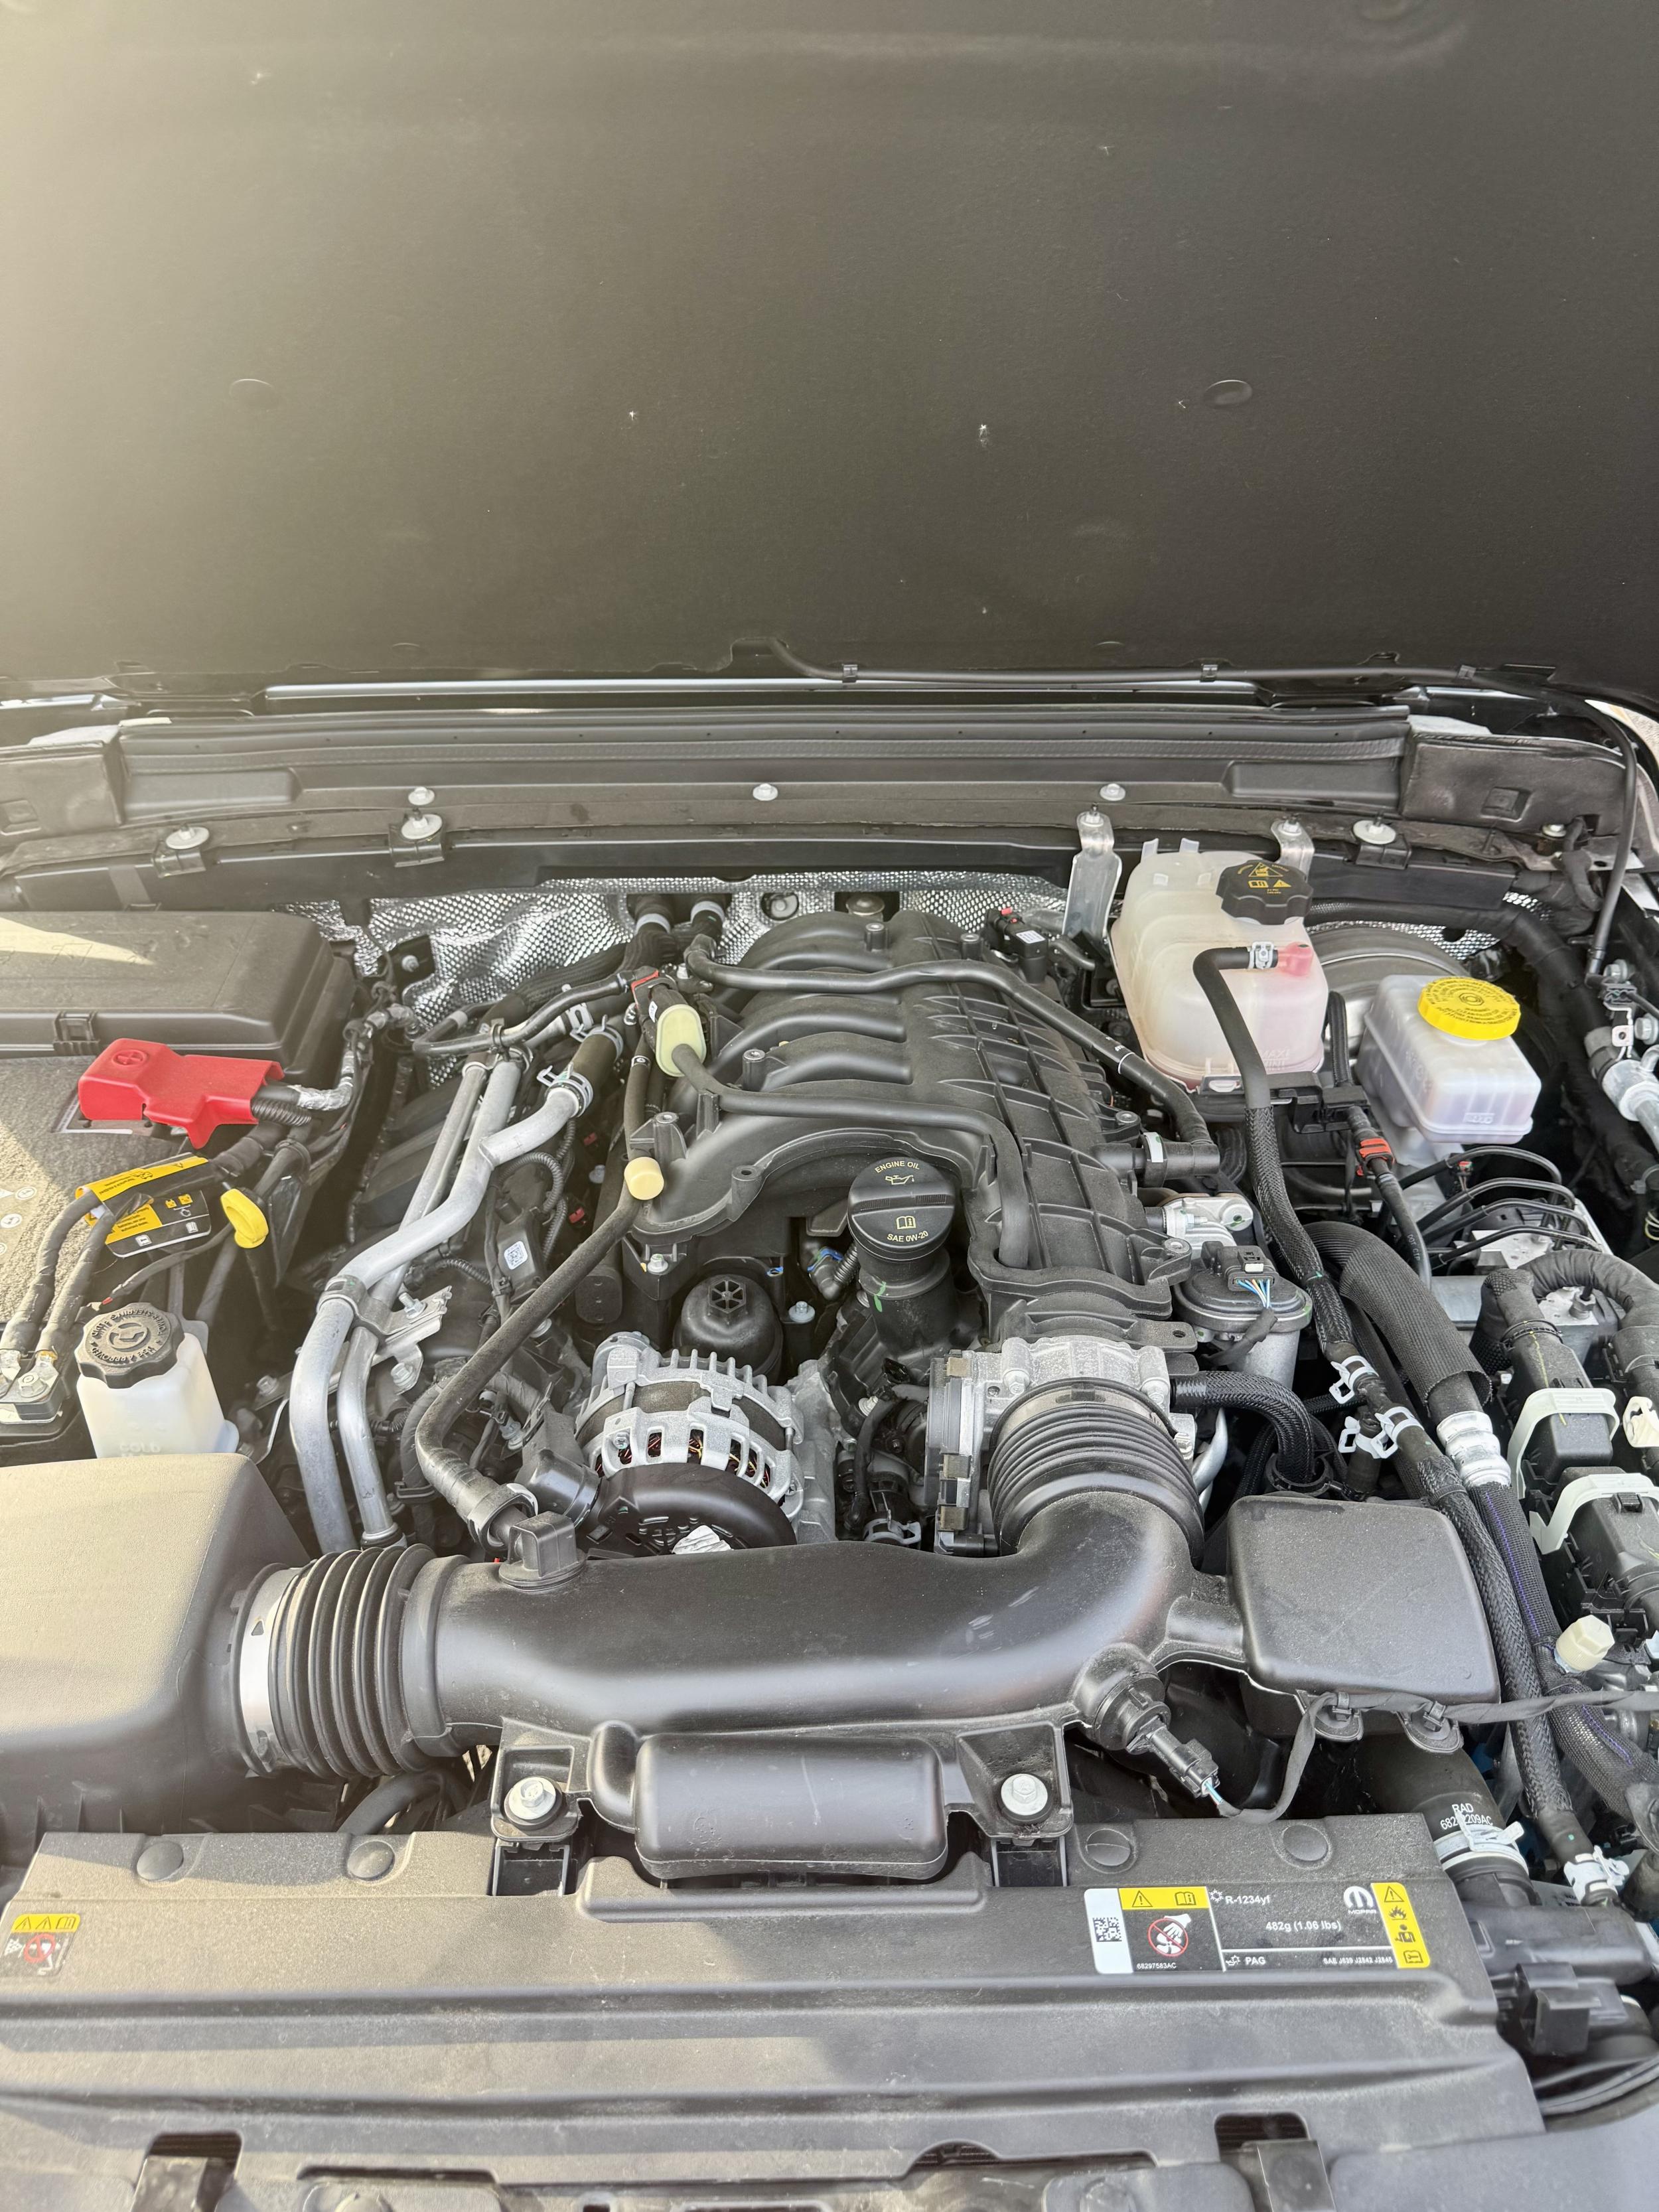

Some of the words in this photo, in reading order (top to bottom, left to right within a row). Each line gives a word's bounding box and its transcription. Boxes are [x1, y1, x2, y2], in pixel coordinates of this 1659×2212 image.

[875, 1161, 905, 1173] ENGINE
[905, 1230, 928, 1242] 0W-20
[1451, 1803, 1474, 1813] RAD
[1440, 1814, 1493, 1830] 682209AC
[1225, 1895, 1270, 1905] R-1234yf
[1265, 1921, 1291, 1933] 482g
[1293, 1921, 1319, 1932] (1.06
[1321, 1920, 1341, 1932] lbs)
